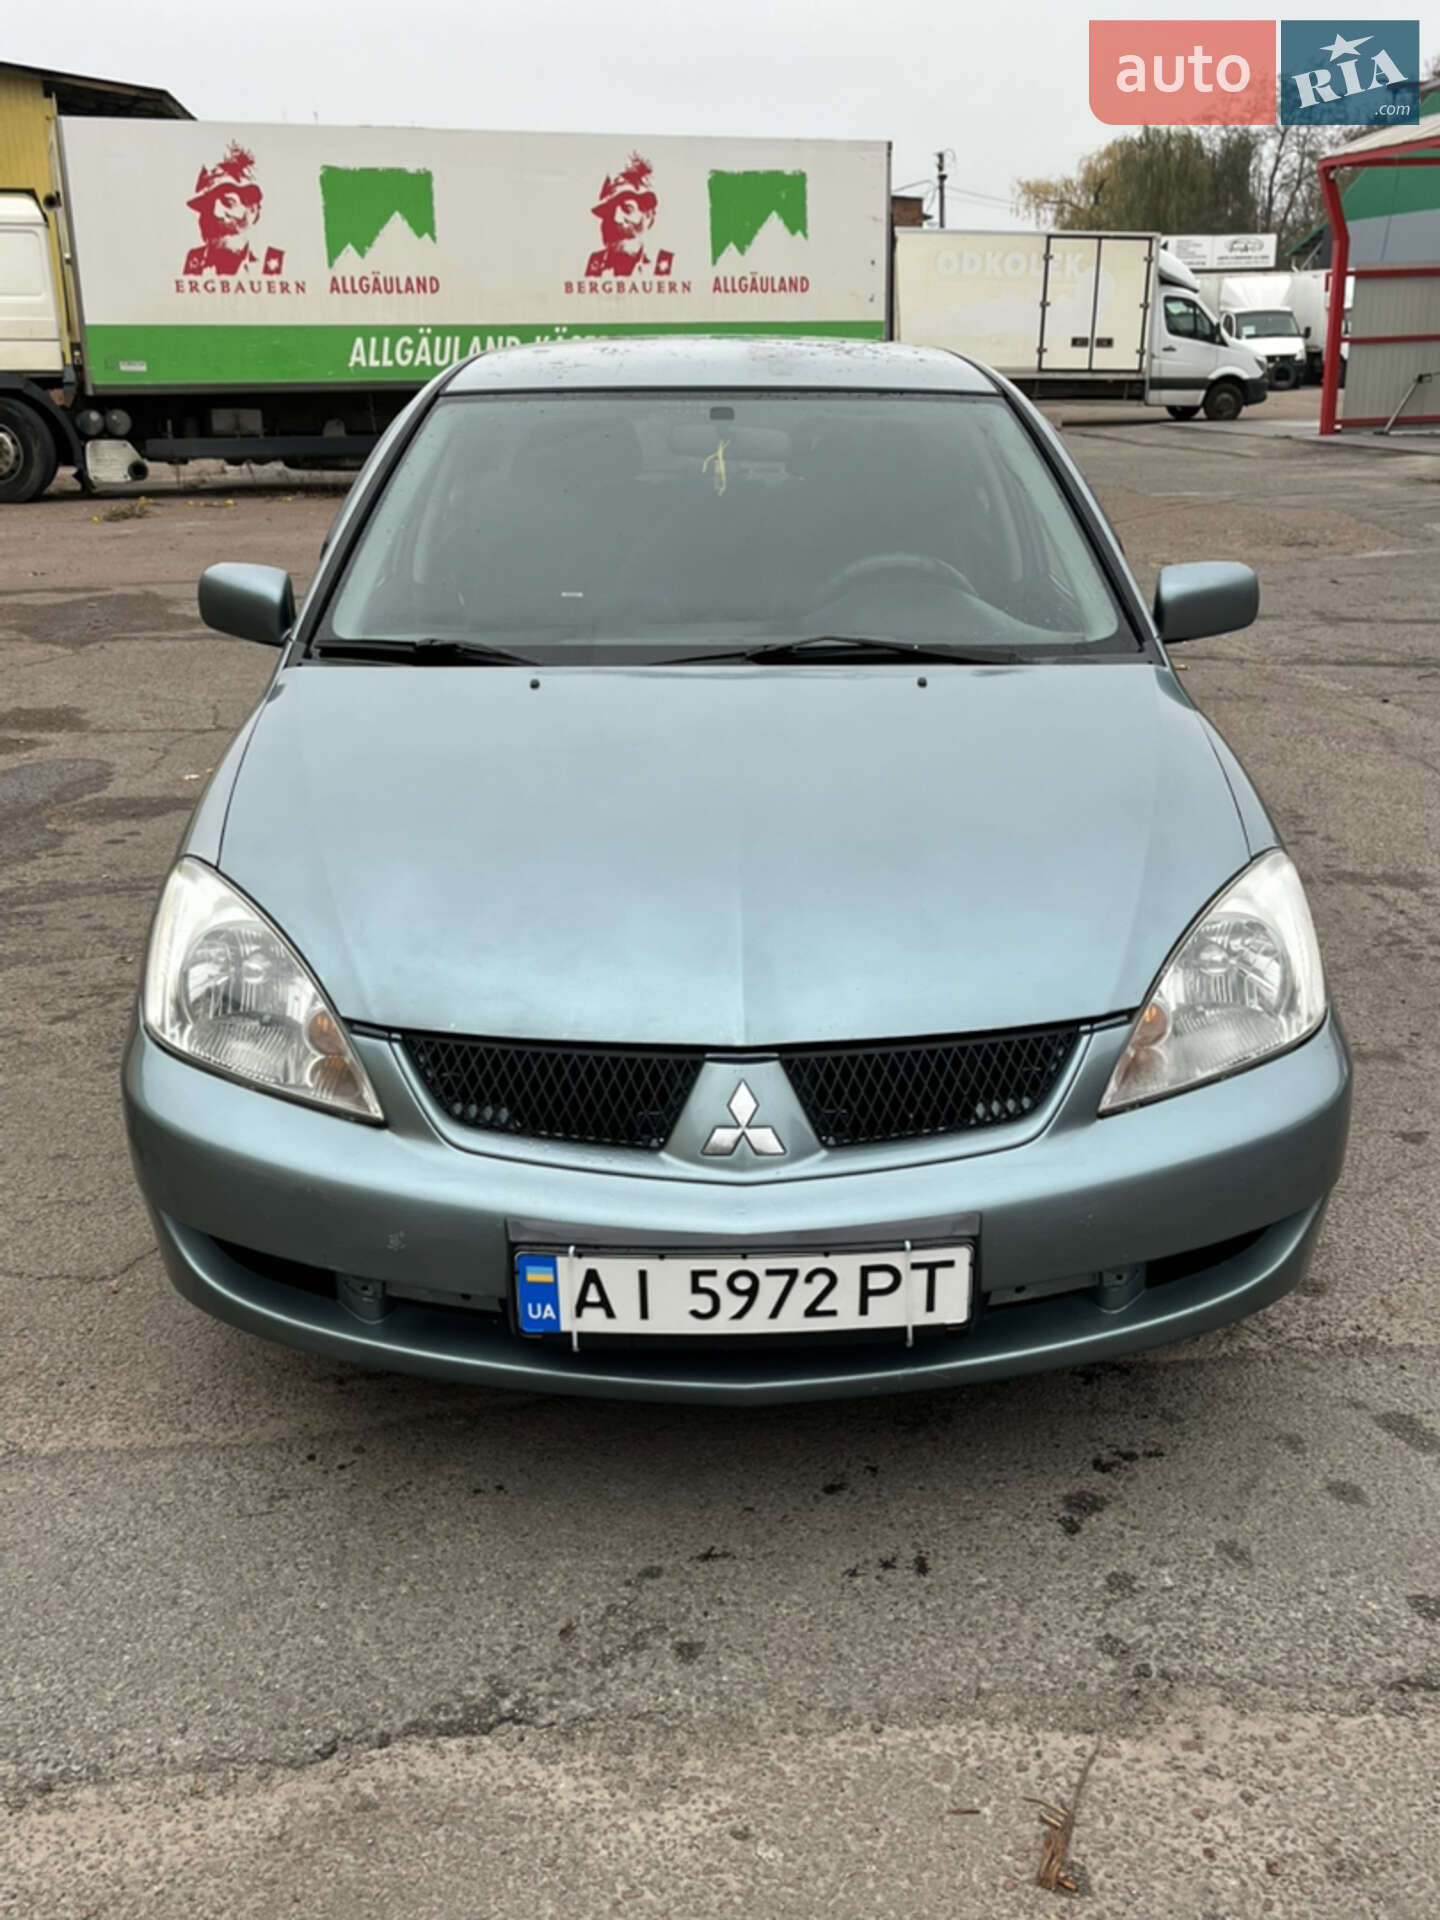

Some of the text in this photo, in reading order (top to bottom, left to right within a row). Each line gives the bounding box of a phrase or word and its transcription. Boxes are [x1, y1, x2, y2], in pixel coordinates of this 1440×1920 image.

[174, 279, 306, 295] ERGBAUERN
[329, 270, 440, 296] ALLGÄULAND
[563, 280, 692, 295] BERGBAUERN
[712, 271, 810, 294] ALLGÄULAND
[574, 1260, 956, 1321] AI 5972 PT
[527, 1302, 557, 1320] UA
